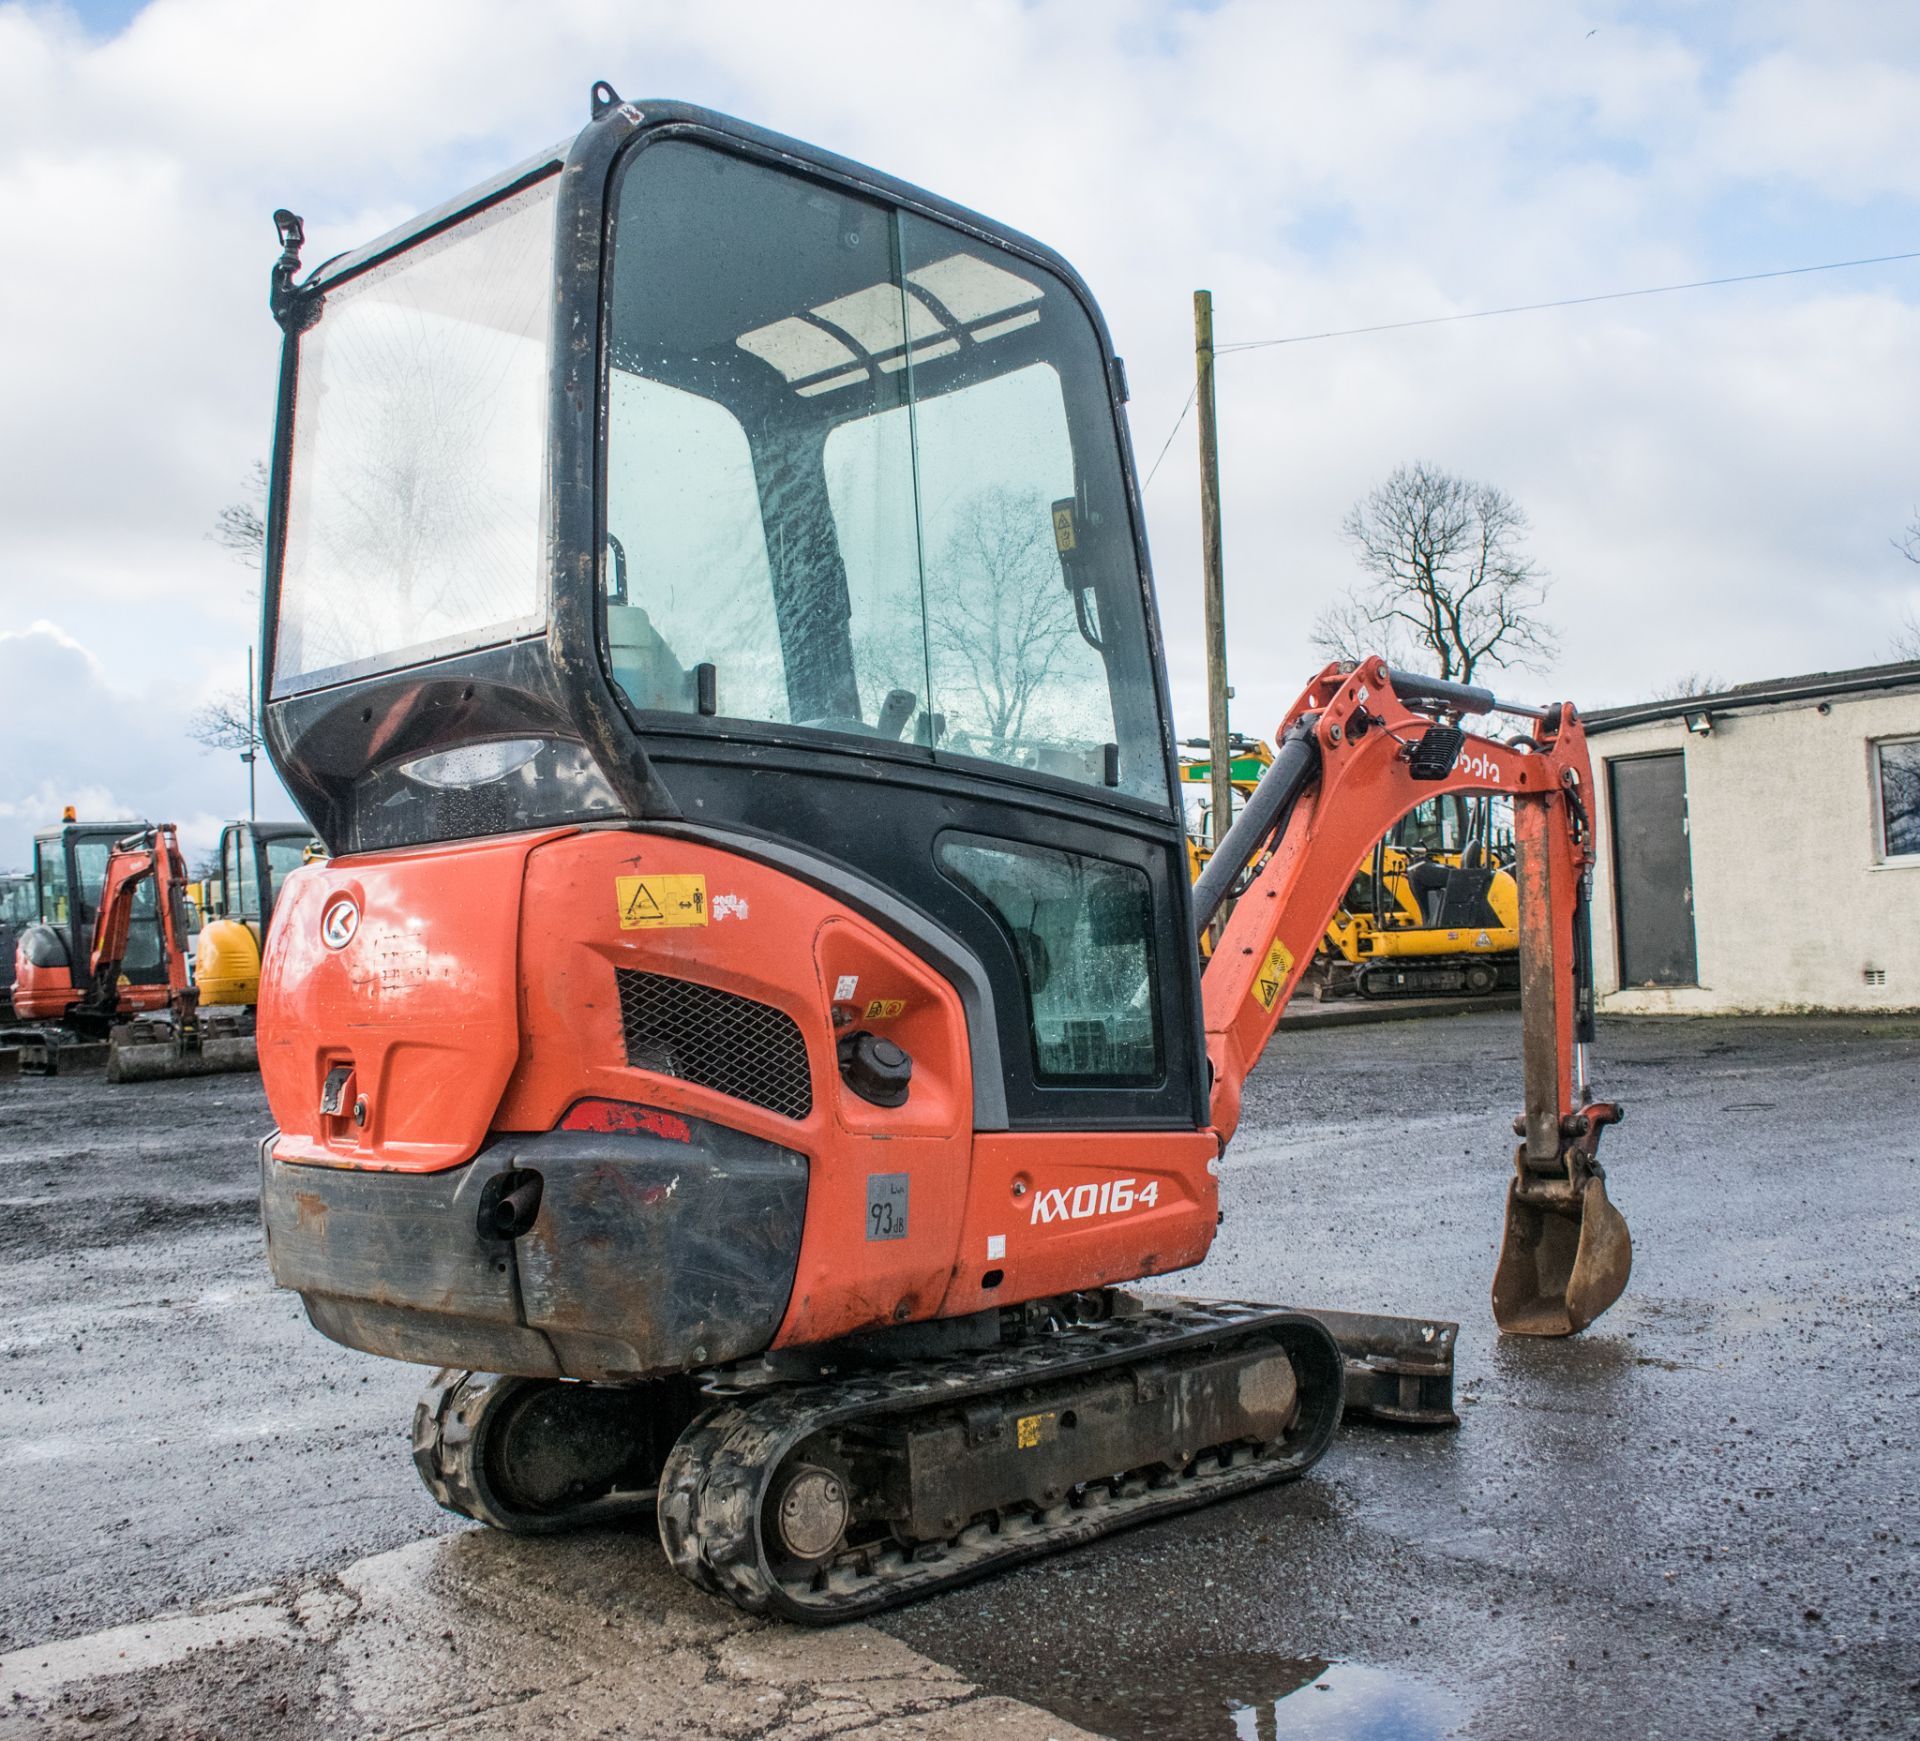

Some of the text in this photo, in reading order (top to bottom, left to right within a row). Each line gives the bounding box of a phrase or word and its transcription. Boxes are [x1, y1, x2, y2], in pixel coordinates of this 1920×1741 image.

[1452, 746, 1500, 784] bota
[871, 1202, 904, 1235] 93 dB
[1030, 1178, 1159, 1225] KX016-4
